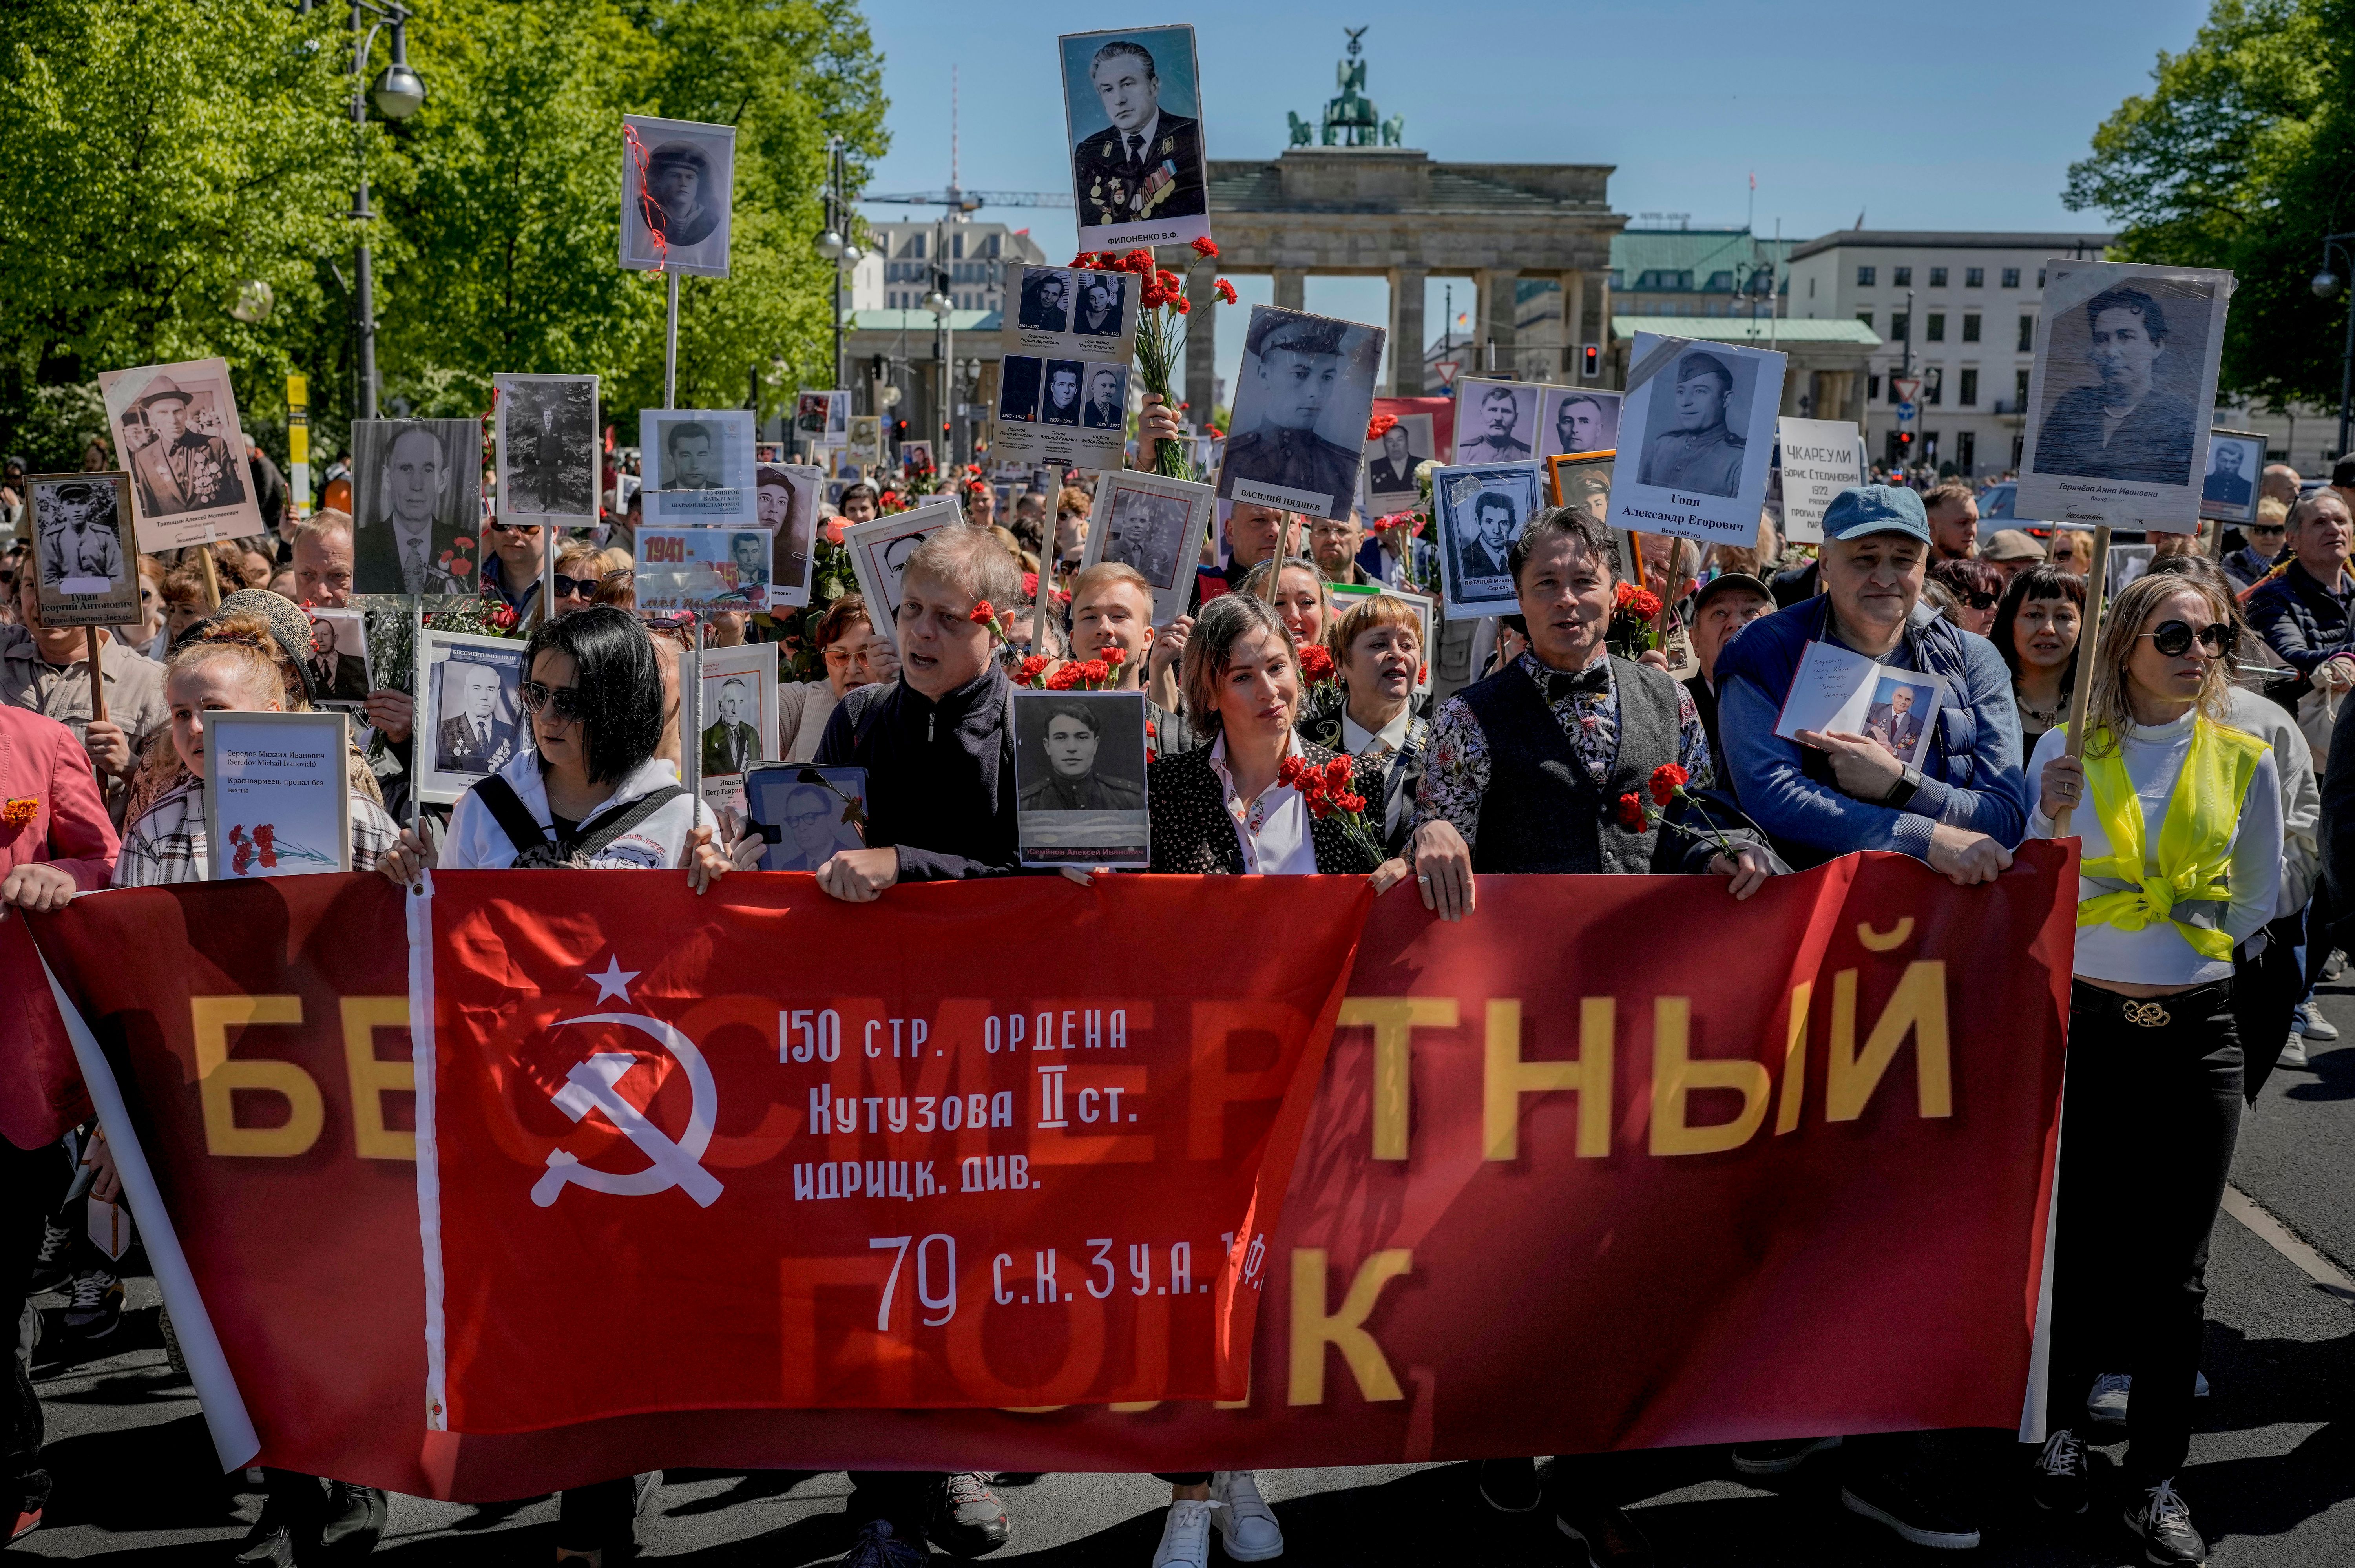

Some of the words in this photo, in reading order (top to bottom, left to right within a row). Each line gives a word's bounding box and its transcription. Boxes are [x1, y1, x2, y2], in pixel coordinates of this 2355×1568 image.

[1108, 233, 1159, 244] ФИЛОНЕНКО
[1787, 445, 1851, 464] ЧКАРЕУЛИ
[1784, 467, 1807, 478] БОРИС
[1809, 469, 1858, 482] СТЕПАНОВИЧ
[1812, 486, 1828, 495] 1922
[2059, 482, 2095, 492] Горячёва
[2119, 487, 2158, 497] Ивановна
[1241, 490, 1282, 504] ВАСИЛИЙ
[1283, 498, 1320, 511] ПЯДШЕВ
[1670, 493, 1700, 507] Гопп
[208, 510, 239, 518] Матвеевич
[1622, 506, 1685, 525] Александр
[1688, 515, 1744, 531] Егорович
[1791, 509, 1816, 518] ПРОПАЛ
[644, 536, 685, 563] 1941
[71, 593, 98, 603] Гуцан
[41, 602, 77, 613] Георгий
[80, 601, 132, 610] Антонович
[44, 617, 68, 626] Орден
[69, 615, 102, 624] Красной
[453, 650, 497, 659] БЕССМЕРТНЫЙ
[228, 777, 282, 785] Красноармеец,
[779, 1009, 841, 1064] 150
[984, 1009, 1127, 1054] ОРДЕНА
[793, 1160, 947, 1202] ИДРИЦК.
[960, 1154, 1041, 1193] ДИВ.
[869, 1233, 957, 1331] 79
